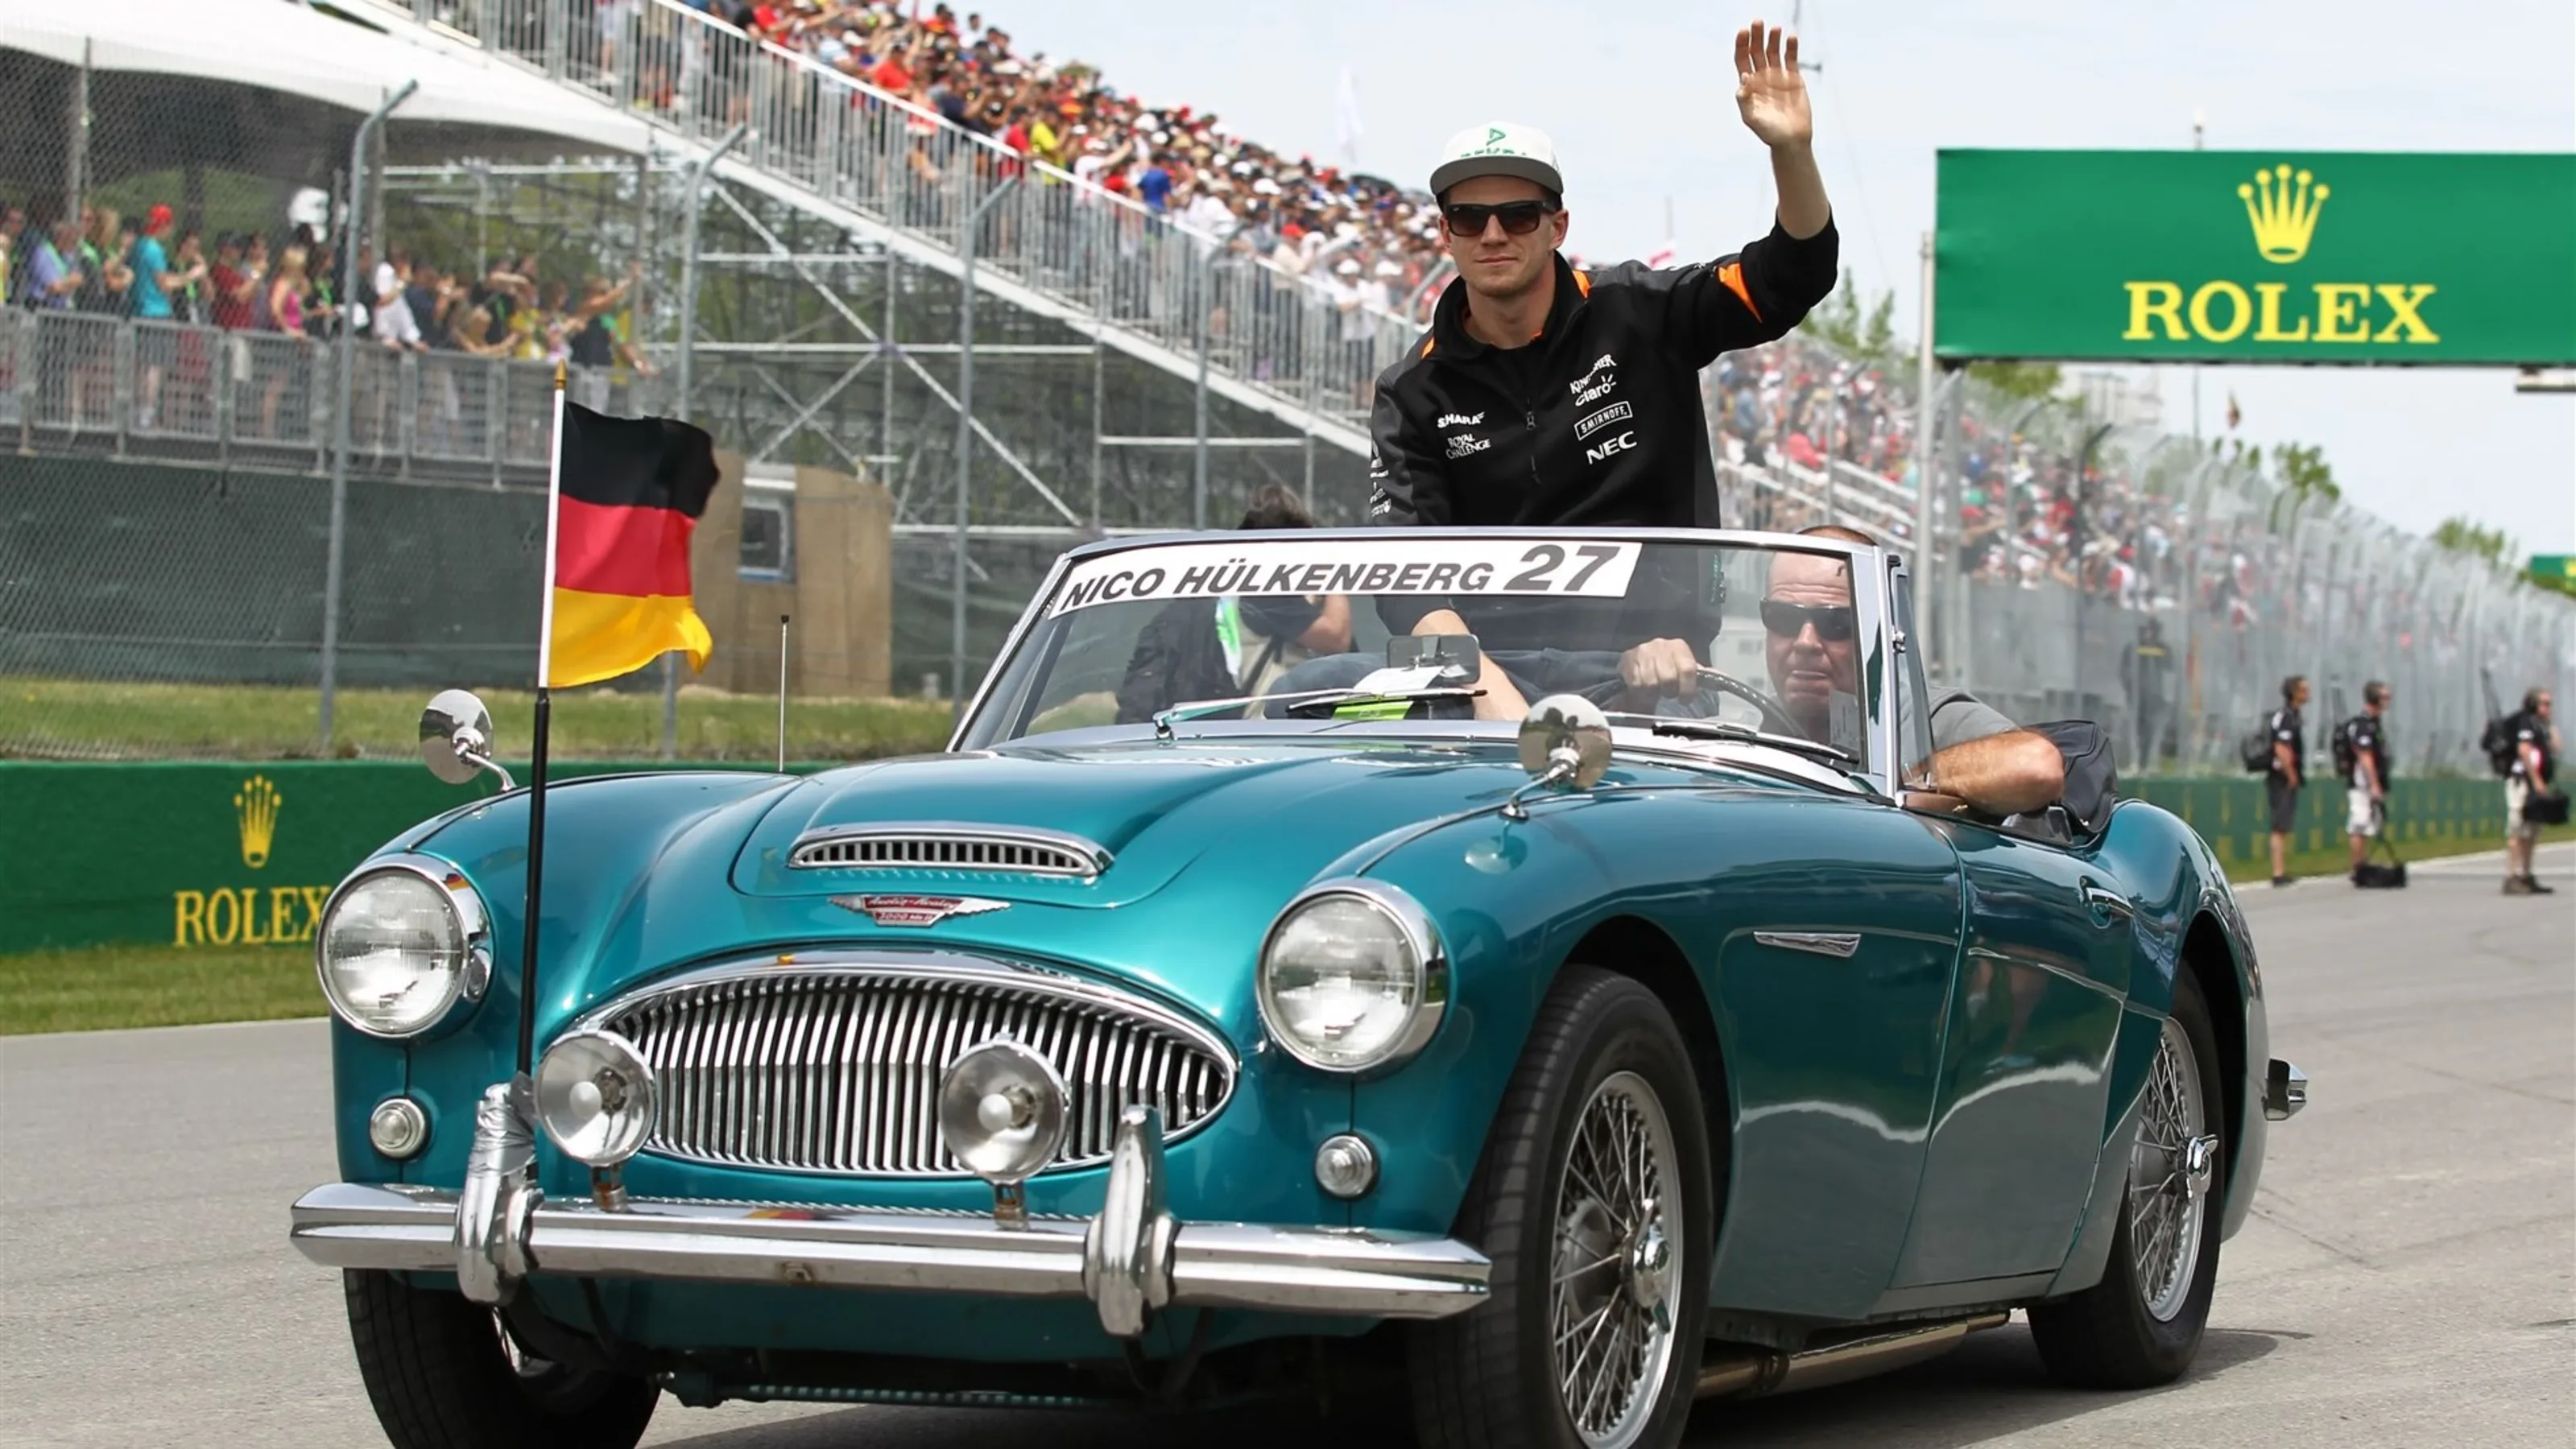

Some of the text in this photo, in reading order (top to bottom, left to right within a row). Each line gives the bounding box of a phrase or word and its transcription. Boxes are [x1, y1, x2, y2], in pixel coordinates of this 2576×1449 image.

[2123, 280, 2440, 343] ROLEX
[1446, 439, 1491, 459] CHALLENGE
[1447, 433, 1476, 448] ROYAL
[1586, 431, 1637, 464] NEC
[1060, 544, 1621, 612] NICO HÜLKENBERG 27
[172, 886, 332, 947] ROLEX
